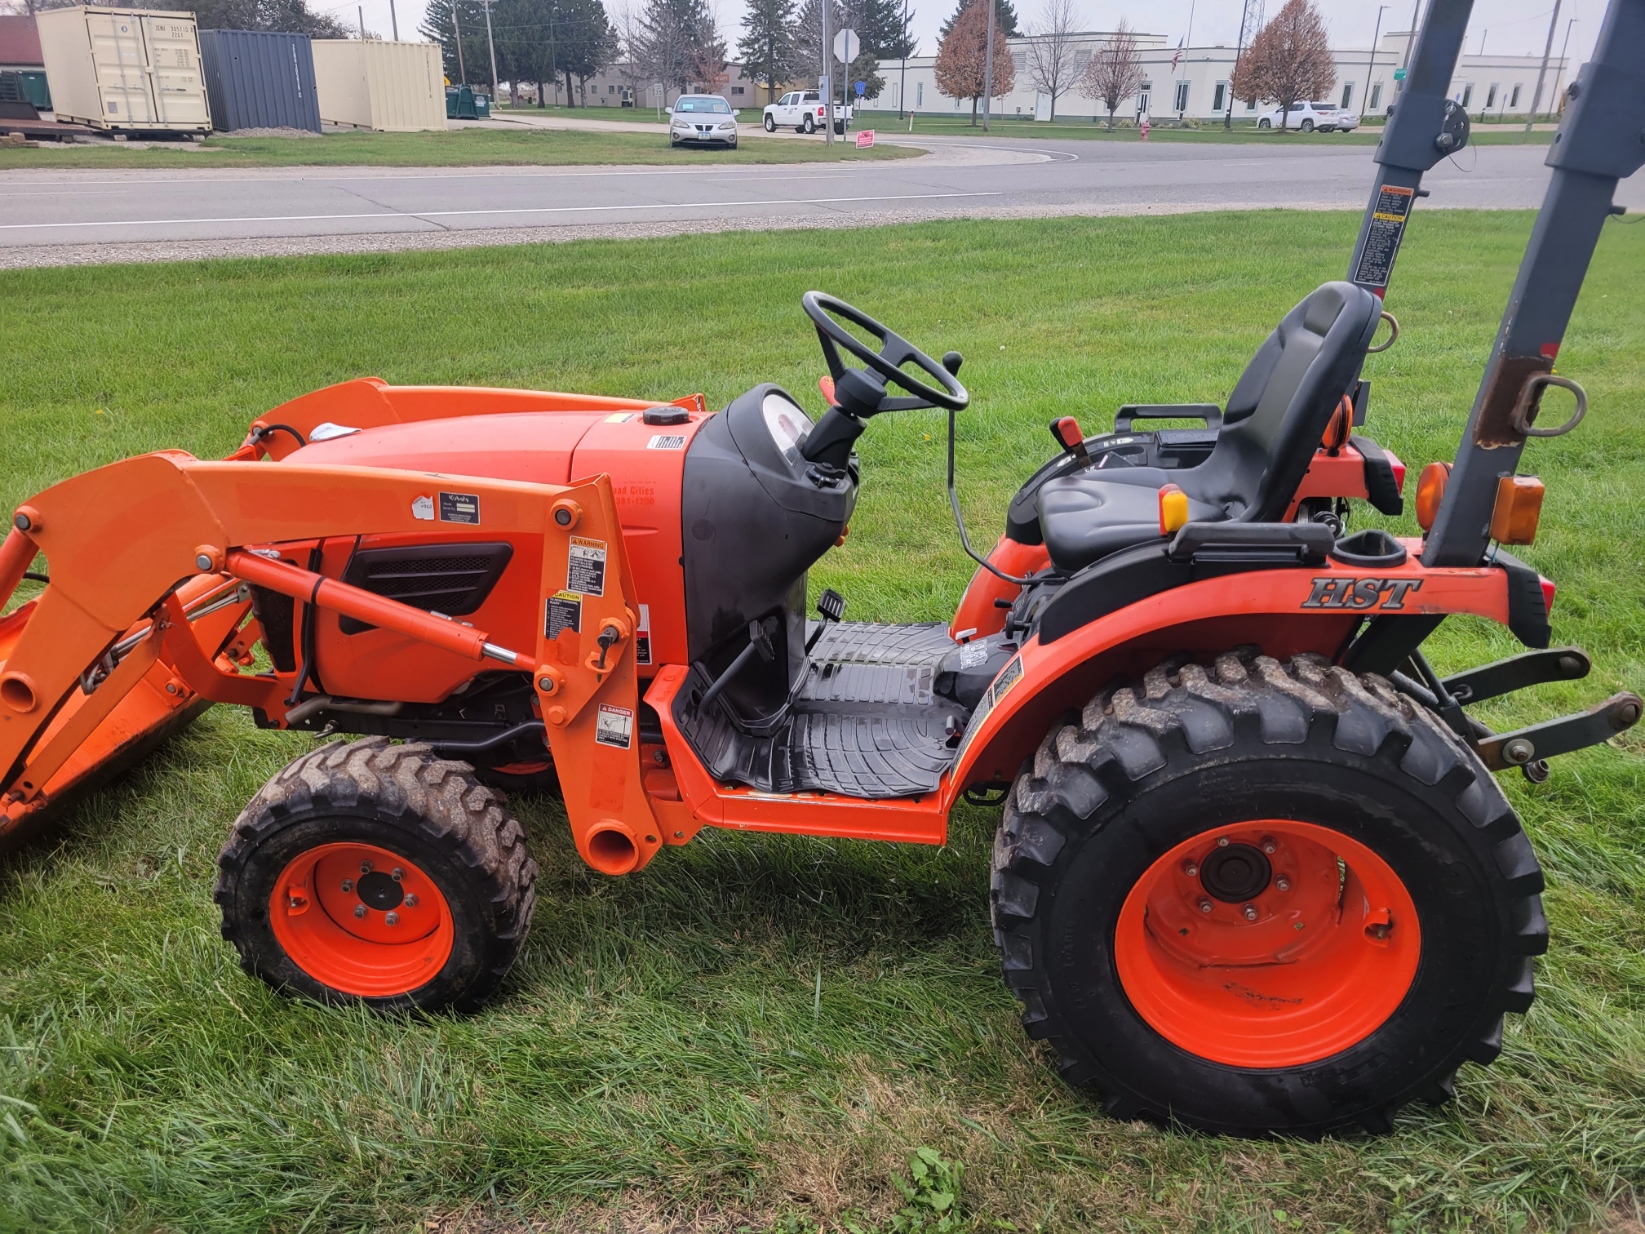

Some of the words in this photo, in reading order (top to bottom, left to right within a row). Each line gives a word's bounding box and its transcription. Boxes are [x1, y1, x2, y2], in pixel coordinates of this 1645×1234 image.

[630, 485, 654, 495] Cities
[578, 540, 604, 549] WARNING
[554, 592, 580, 600] CAUTION
[1300, 577, 1424, 610] HST
[607, 707, 631, 716] DANGER
